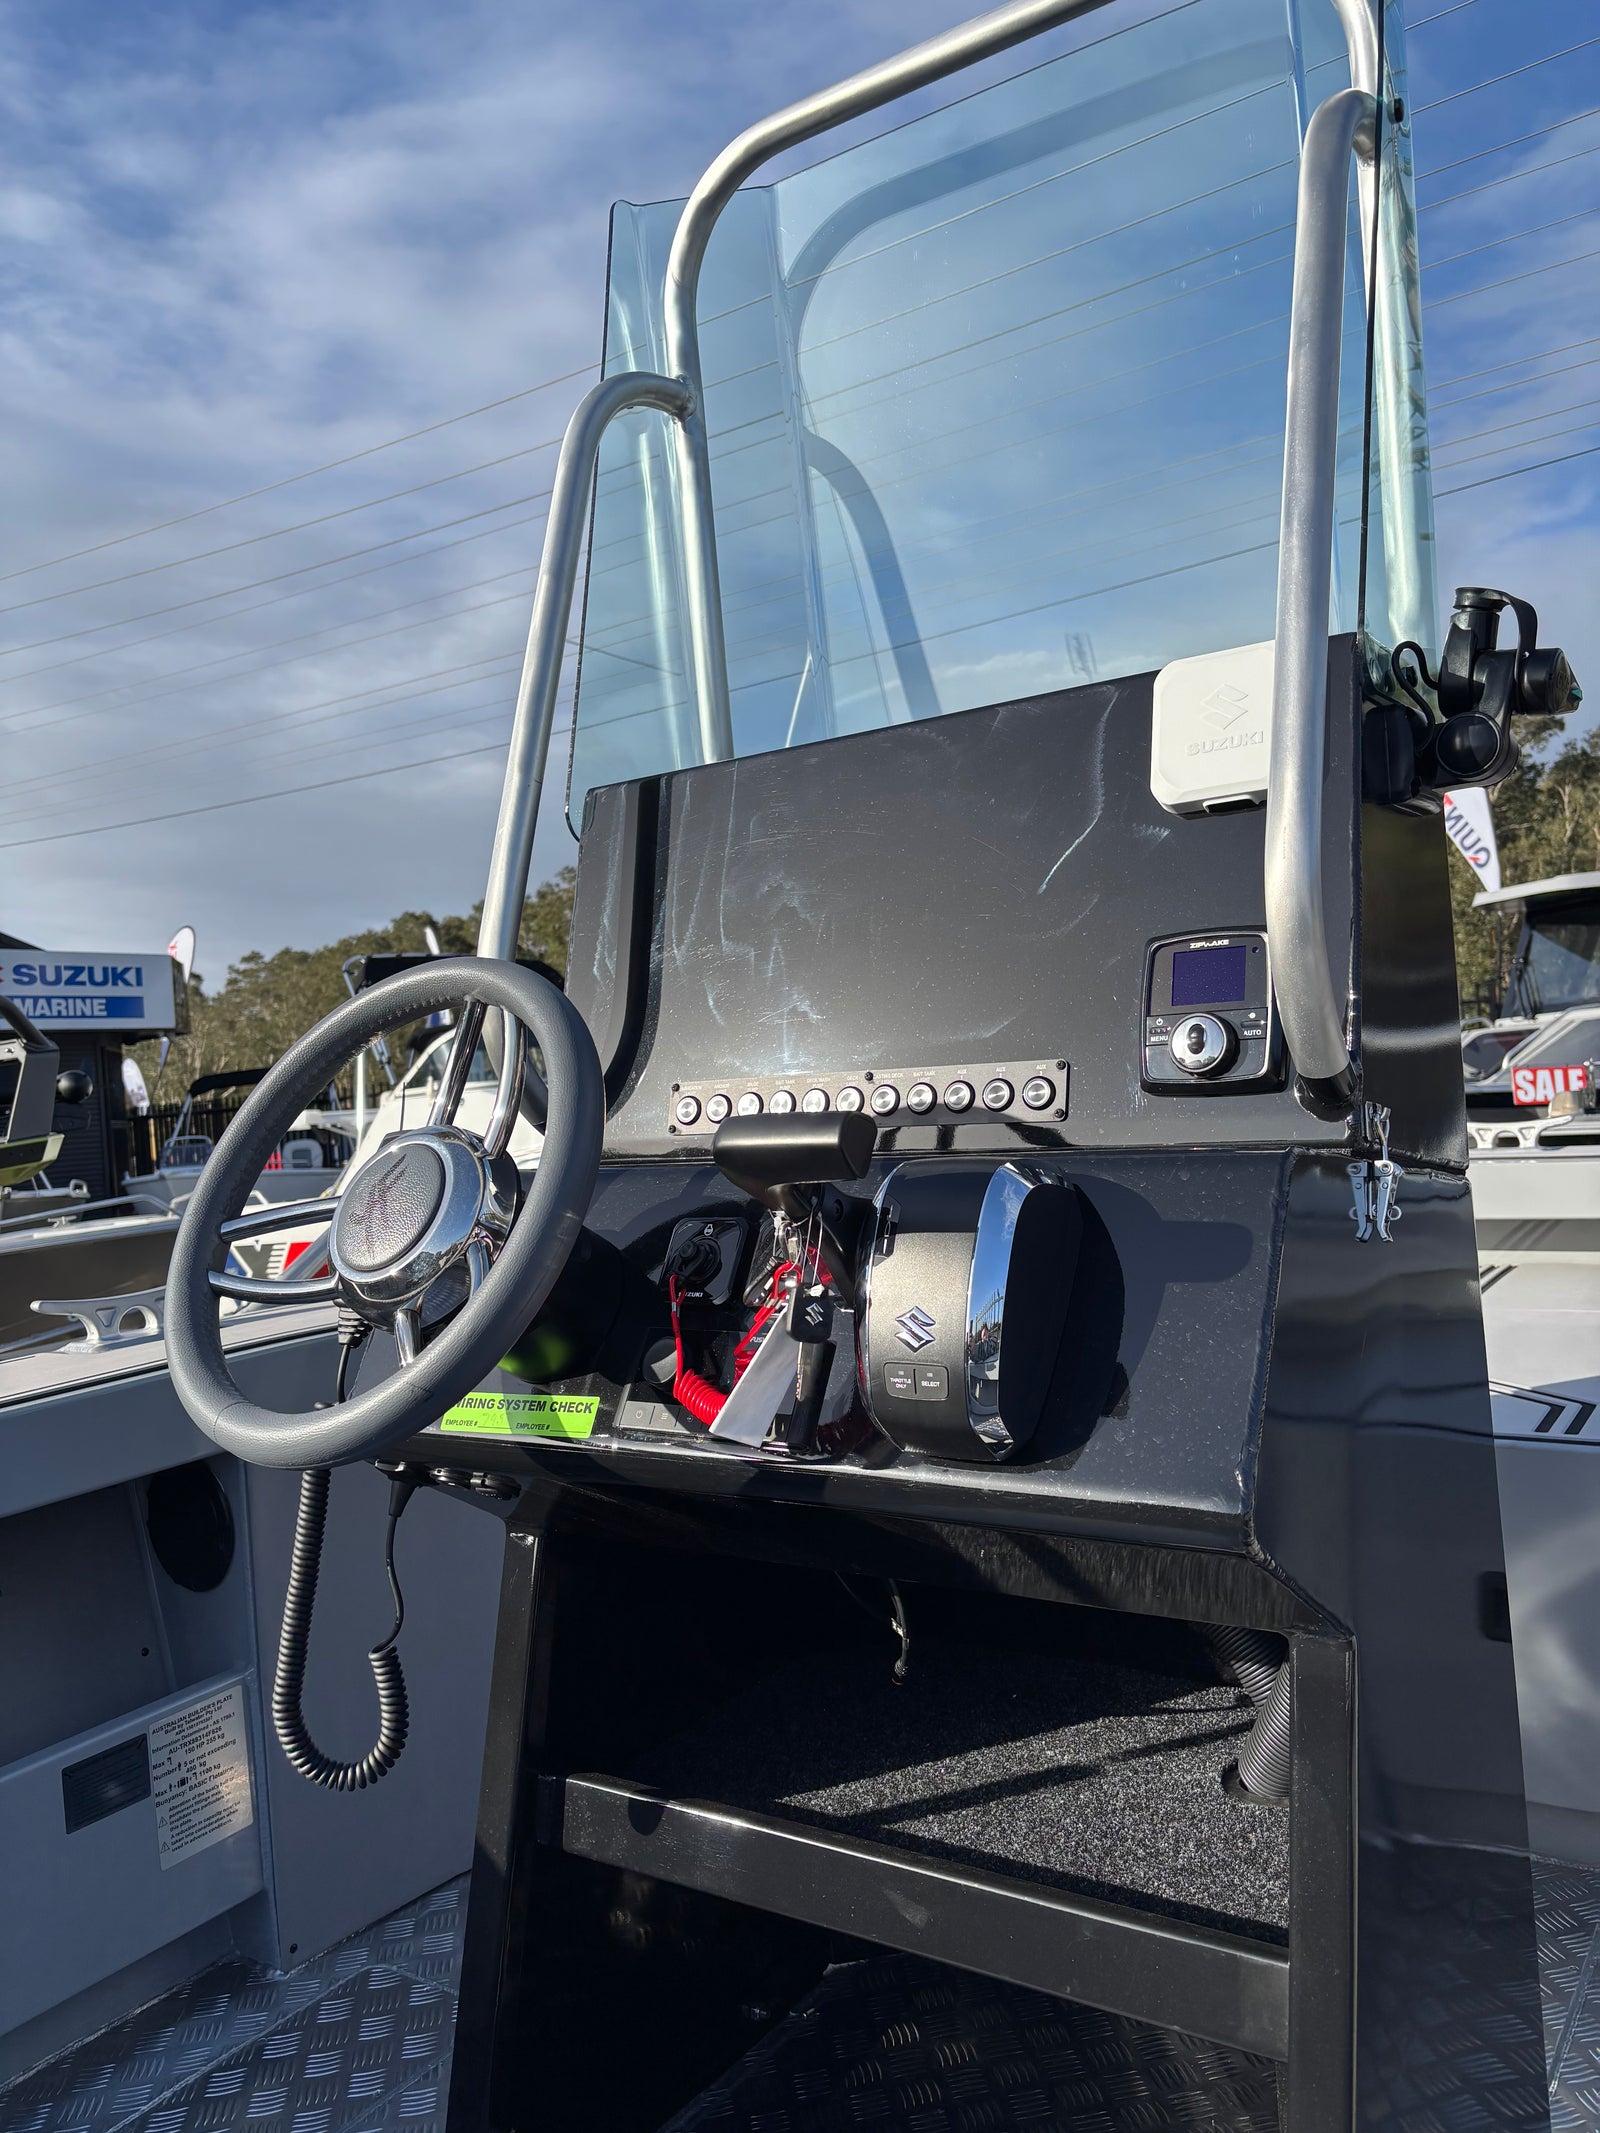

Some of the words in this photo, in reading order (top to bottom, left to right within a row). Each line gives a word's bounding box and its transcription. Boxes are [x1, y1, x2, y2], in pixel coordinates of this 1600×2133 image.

[1187, 730, 1264, 757] SUZUKI
[1190, 939, 1230, 949] ZIPWAKE
[12, 964, 143, 987] SUZUKI
[15, 997, 107, 1016] MARINE
[1514, 1067, 1583, 1103] SALE
[497, 1399, 547, 1412] SYSTEM
[549, 1401, 594, 1414] CHECK
[445, 1419, 474, 1427] EMPLOYEE
[516, 1422, 546, 1431] EMPLOYEE
[151, 1715, 187, 1735] AUSTRALIAN
[216, 1694, 233, 1705] PLATE
[153, 1760, 165, 1770] Max
[154, 1766, 178, 1781] Number
[207, 1737, 237, 1757] exceeding
[188, 1778, 208, 1792] BASIC
